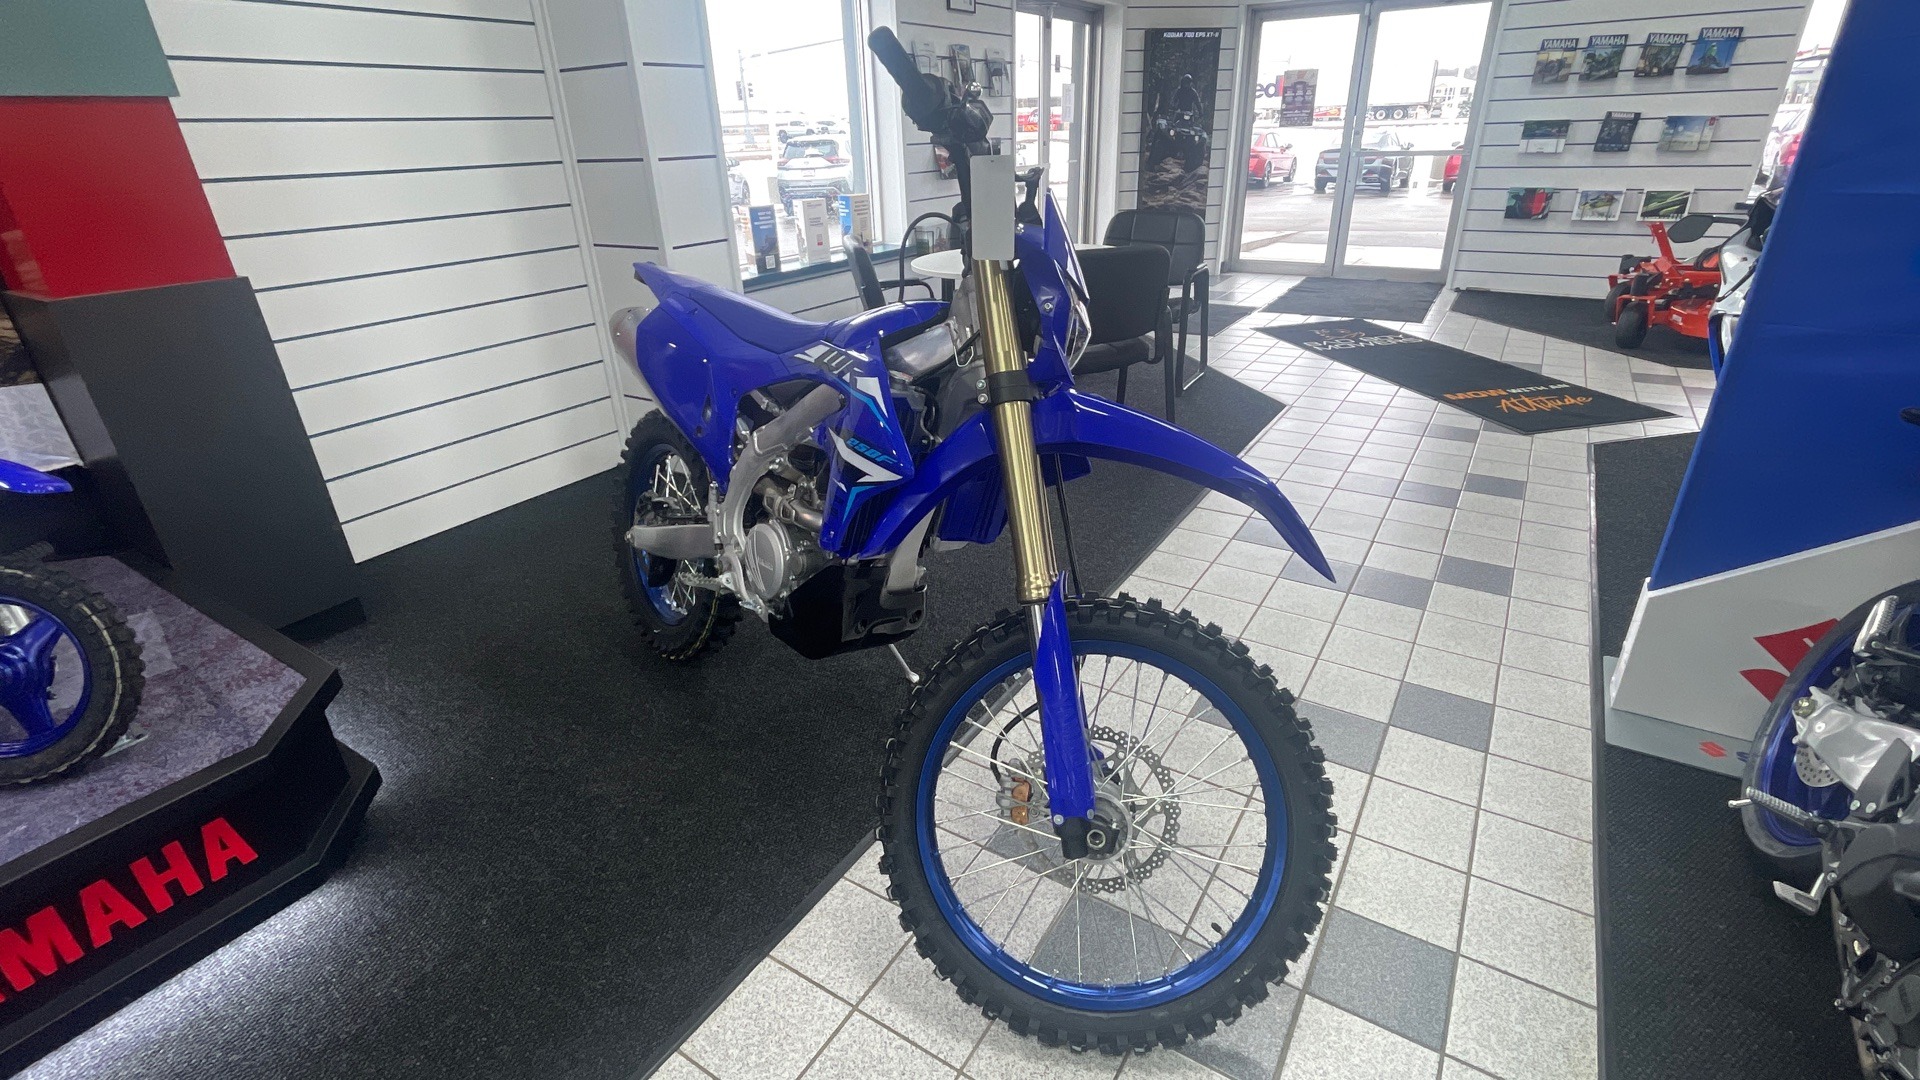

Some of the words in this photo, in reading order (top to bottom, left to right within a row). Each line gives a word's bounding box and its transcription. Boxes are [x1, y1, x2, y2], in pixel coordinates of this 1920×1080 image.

[1649, 33, 1686, 44] YAMAHA
[1702, 28, 1740, 38] YAMAHA
[1543, 39, 1577, 49] YAMAHA
[1591, 35, 1626, 46] YAMAHA
[1443, 388, 1508, 400] MOW
[1507, 385, 1549, 394] WITH
[1496, 394, 1593, 413] Attitude
[846, 437, 898, 464] 250F
[0, 817, 259, 1002] MAHA
